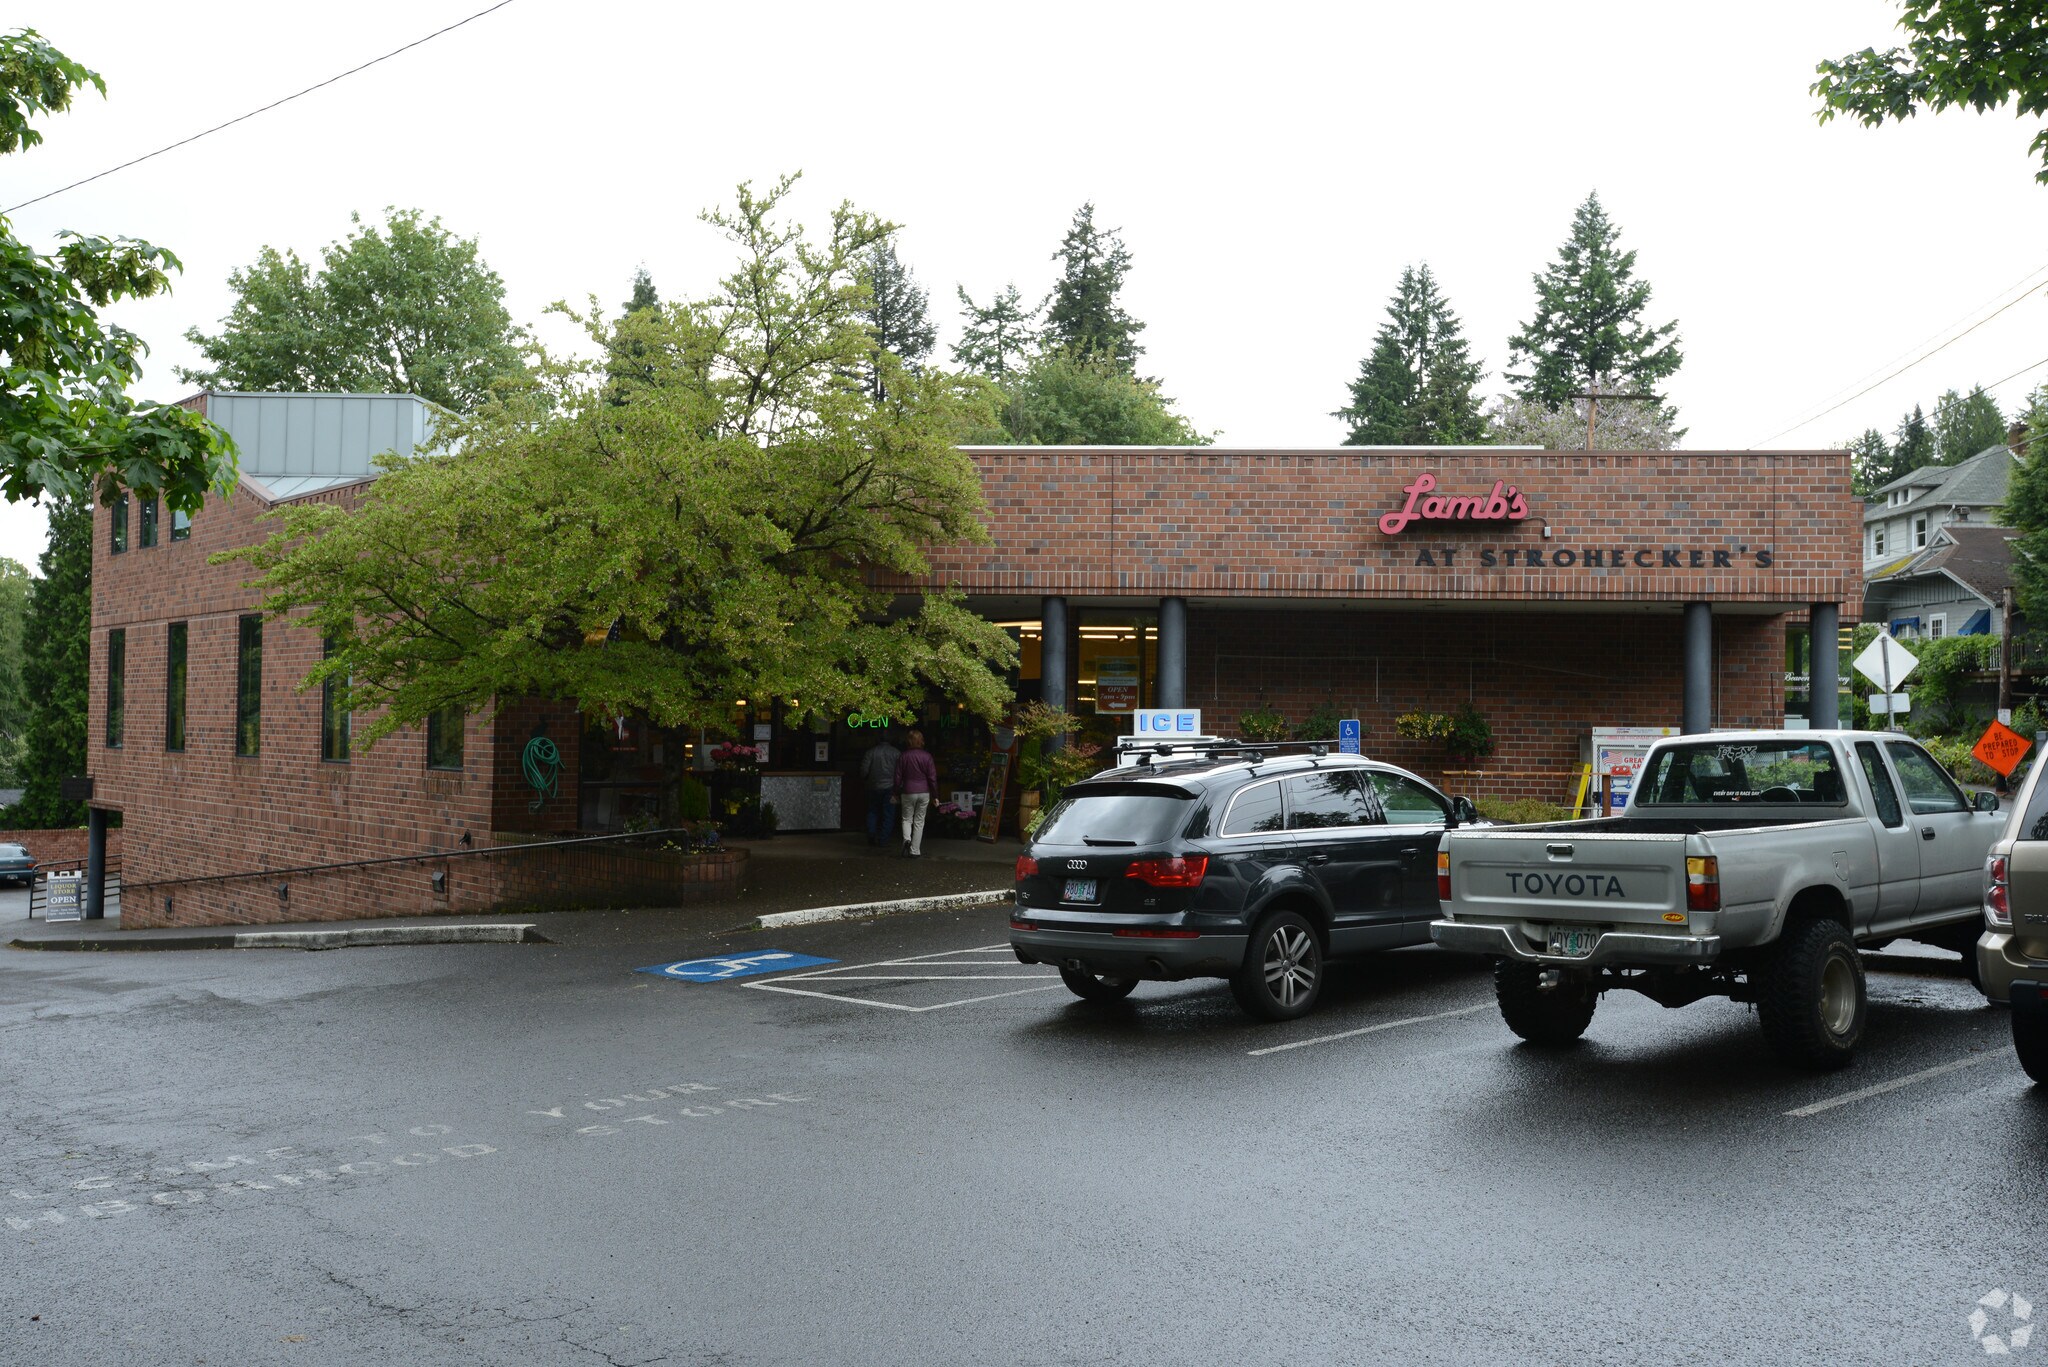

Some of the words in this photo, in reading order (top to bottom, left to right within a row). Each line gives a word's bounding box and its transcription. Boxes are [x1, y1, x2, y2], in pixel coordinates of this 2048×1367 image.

[1378, 472, 1529, 535] Lamb's
[1414, 549, 1458, 567] AT
[1480, 546, 1773, 569] STROHECKER'S
[1140, 713, 1195, 732] ICE
[1983, 738, 2018, 752] PREPARED
[1993, 732, 2003, 741] BE
[1985, 751, 1994, 760] TO
[2002, 747, 2019, 758] STOP
[1505, 872, 1626, 897] TOYOTA
[50, 895, 77, 904] OPEN
[1576, 932, 1598, 949] 070
[525, 1082, 721, 1118] YOUR
[575, 1091, 812, 1136] STORE
